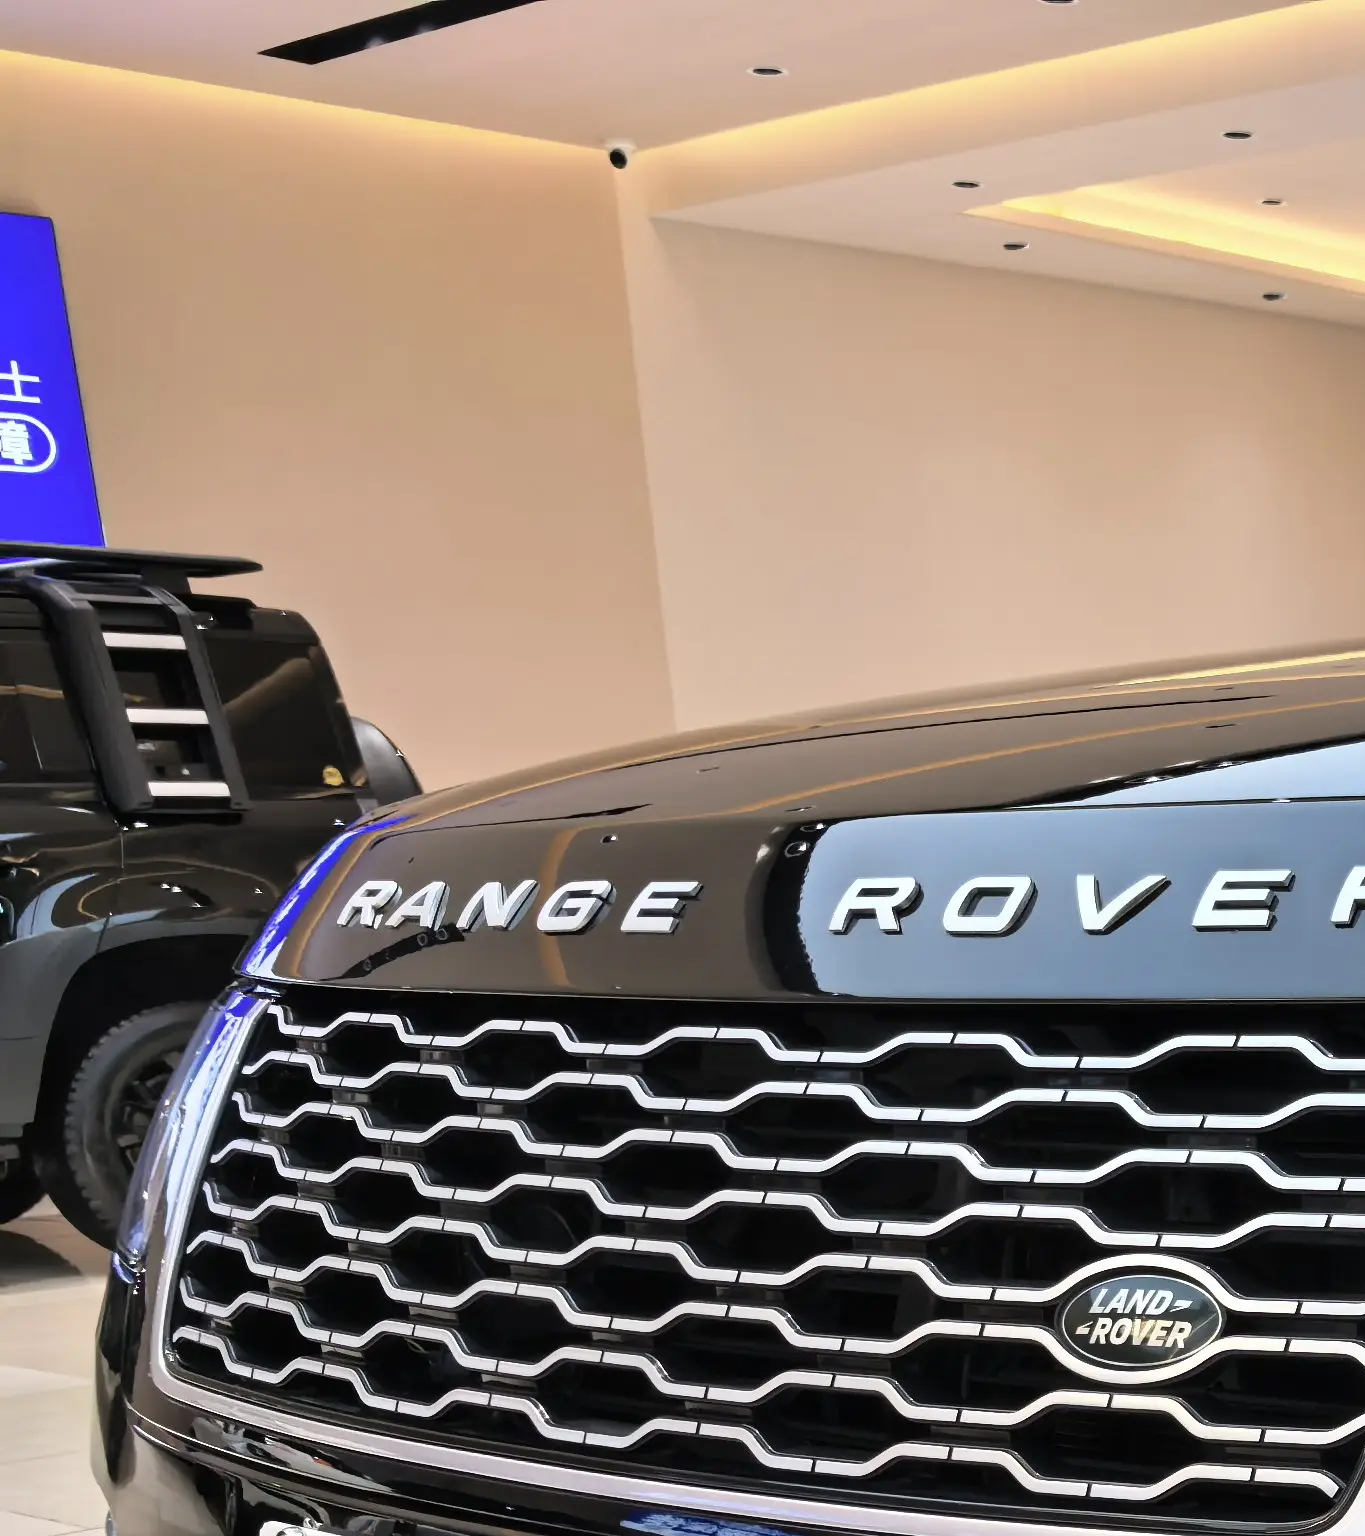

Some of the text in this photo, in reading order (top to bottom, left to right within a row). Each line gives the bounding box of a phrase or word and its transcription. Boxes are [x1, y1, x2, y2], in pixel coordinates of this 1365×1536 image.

[336, 878, 704, 936] RANGE
[1089, 1288, 1174, 1316] LAND
[1088, 1317, 1193, 1349] ROVER
